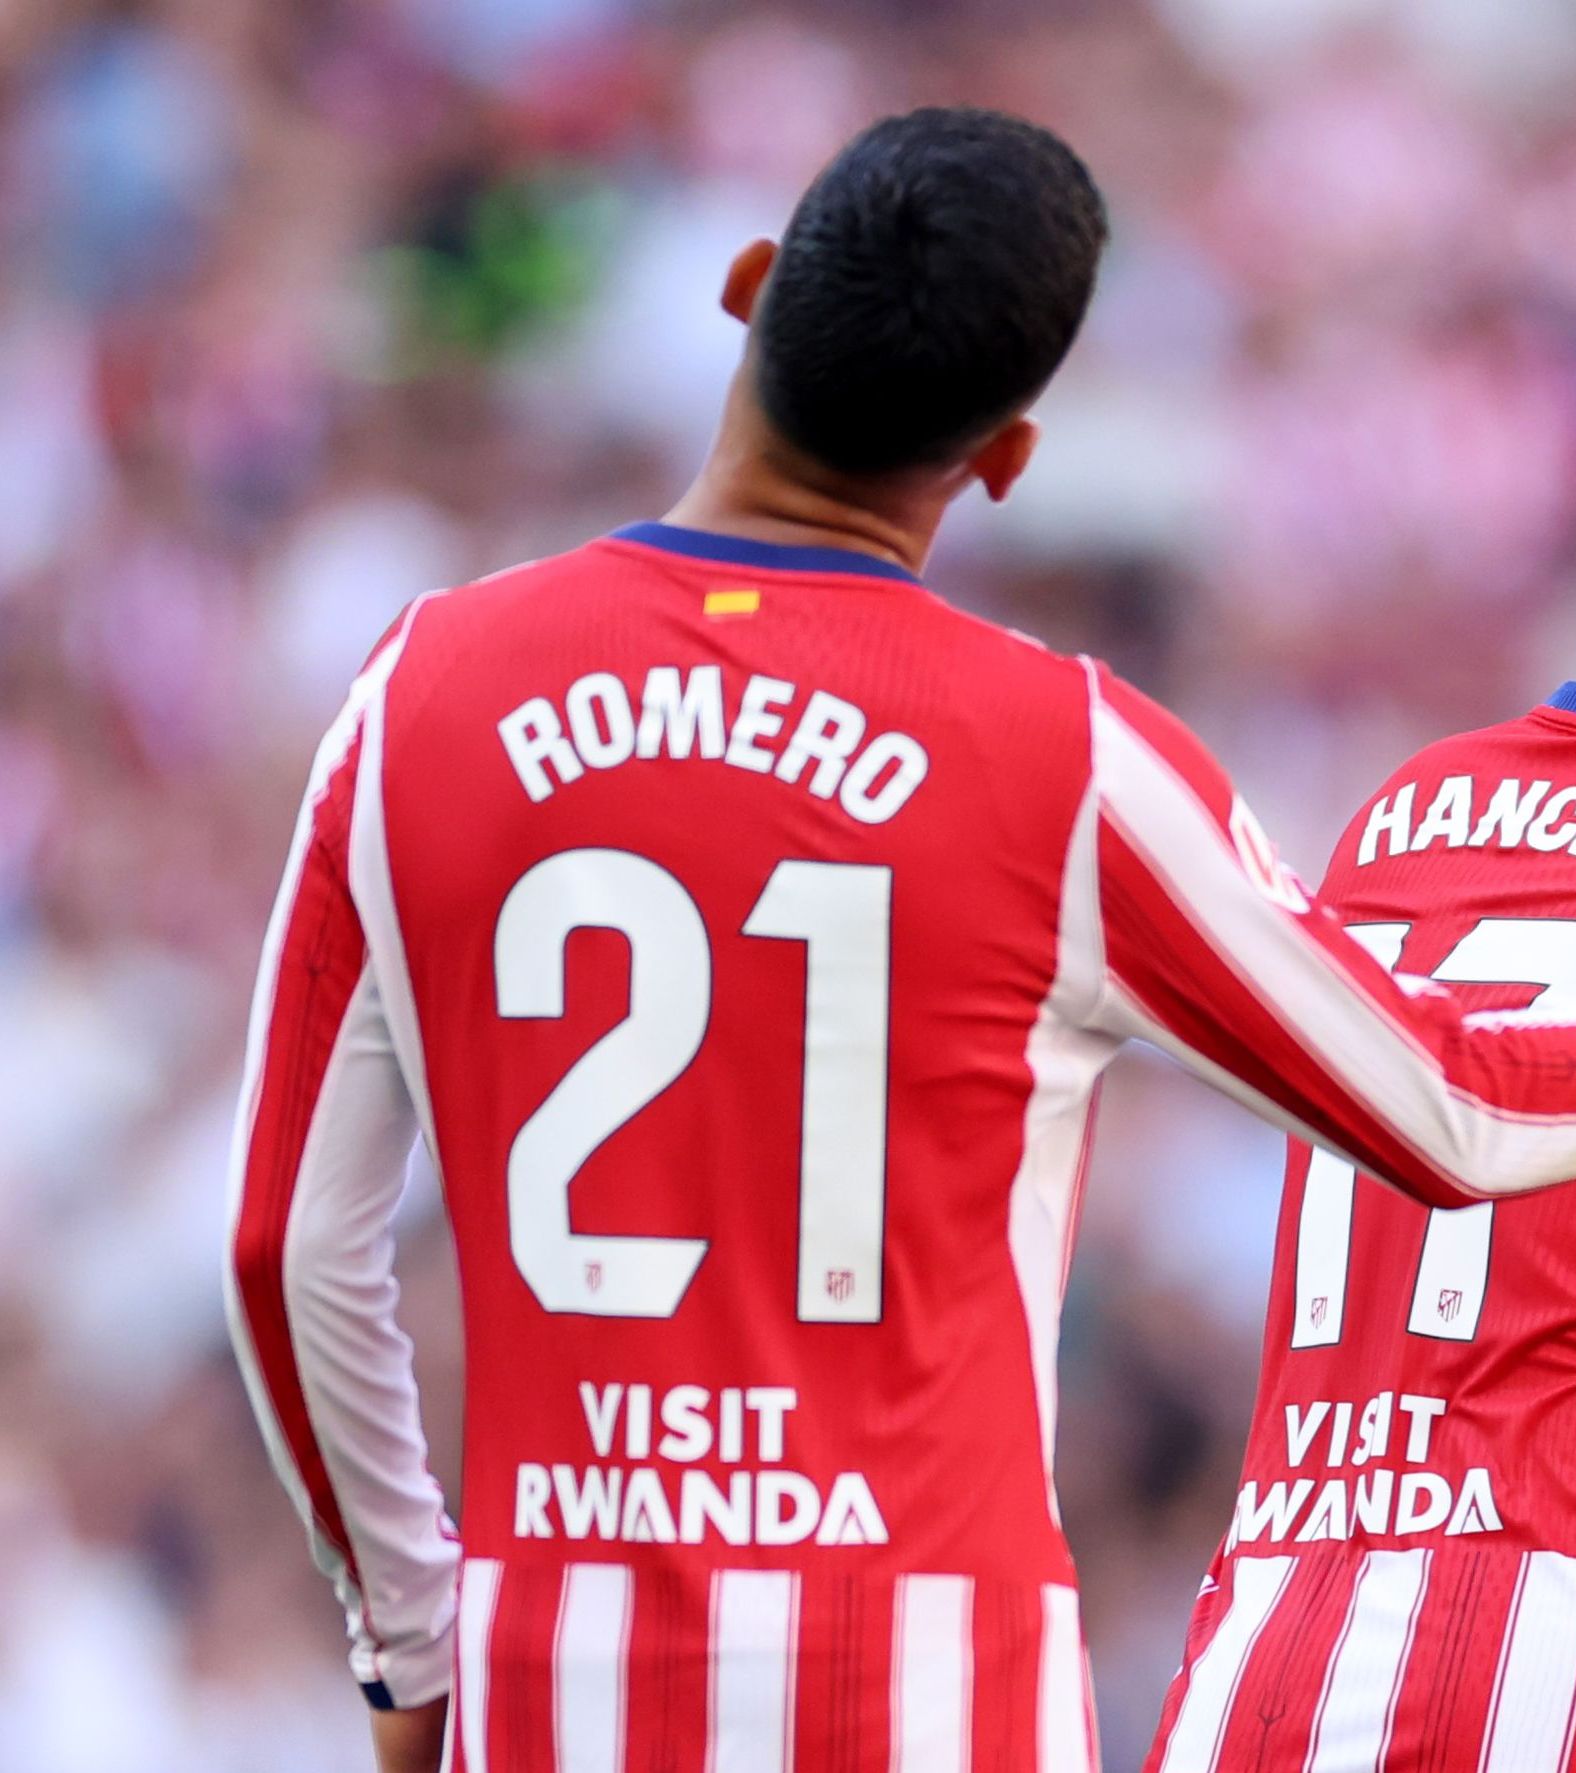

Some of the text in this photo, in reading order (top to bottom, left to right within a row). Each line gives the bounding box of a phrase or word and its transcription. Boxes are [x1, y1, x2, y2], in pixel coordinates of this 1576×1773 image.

[497, 665, 929, 824] ROMERO
[493, 846, 892, 1323] 21
[579, 1380, 797, 1462] VISIT
[1285, 1391, 1447, 1468] VISIT
[514, 1463, 890, 1547] RWANDA
